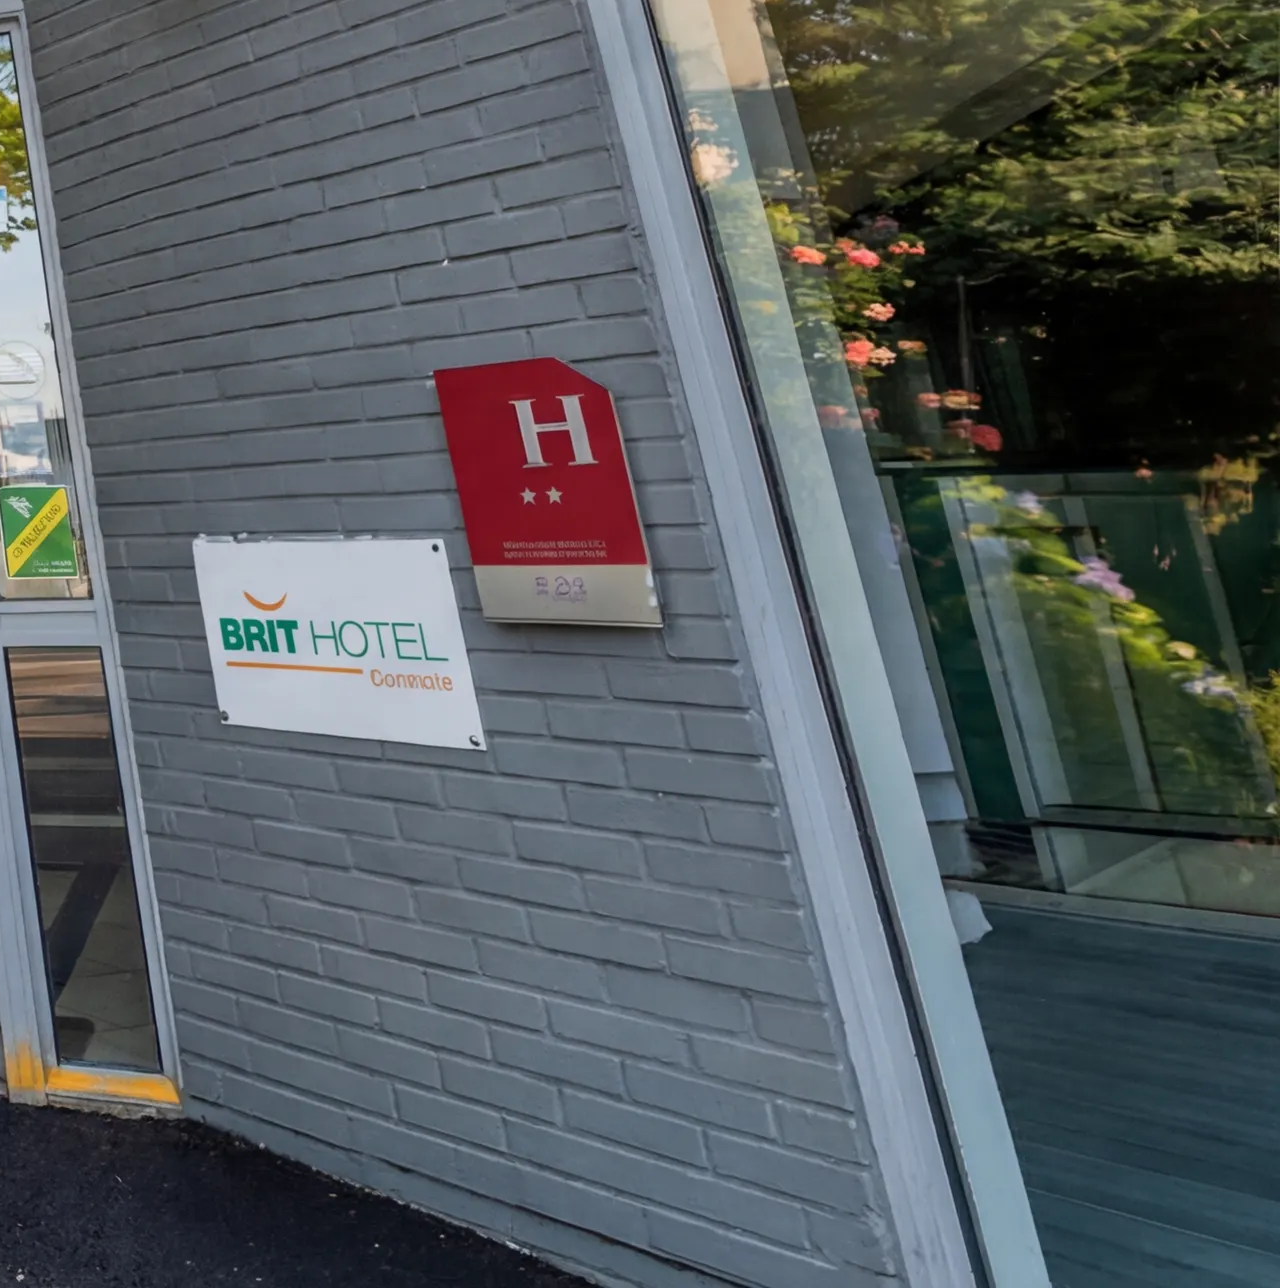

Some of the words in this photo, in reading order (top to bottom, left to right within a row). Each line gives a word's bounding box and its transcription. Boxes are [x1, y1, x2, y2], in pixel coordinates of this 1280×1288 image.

[508, 393, 599, 468] H
[219, 617, 298, 654] BRIT
[309, 620, 449, 661] HOTEL
